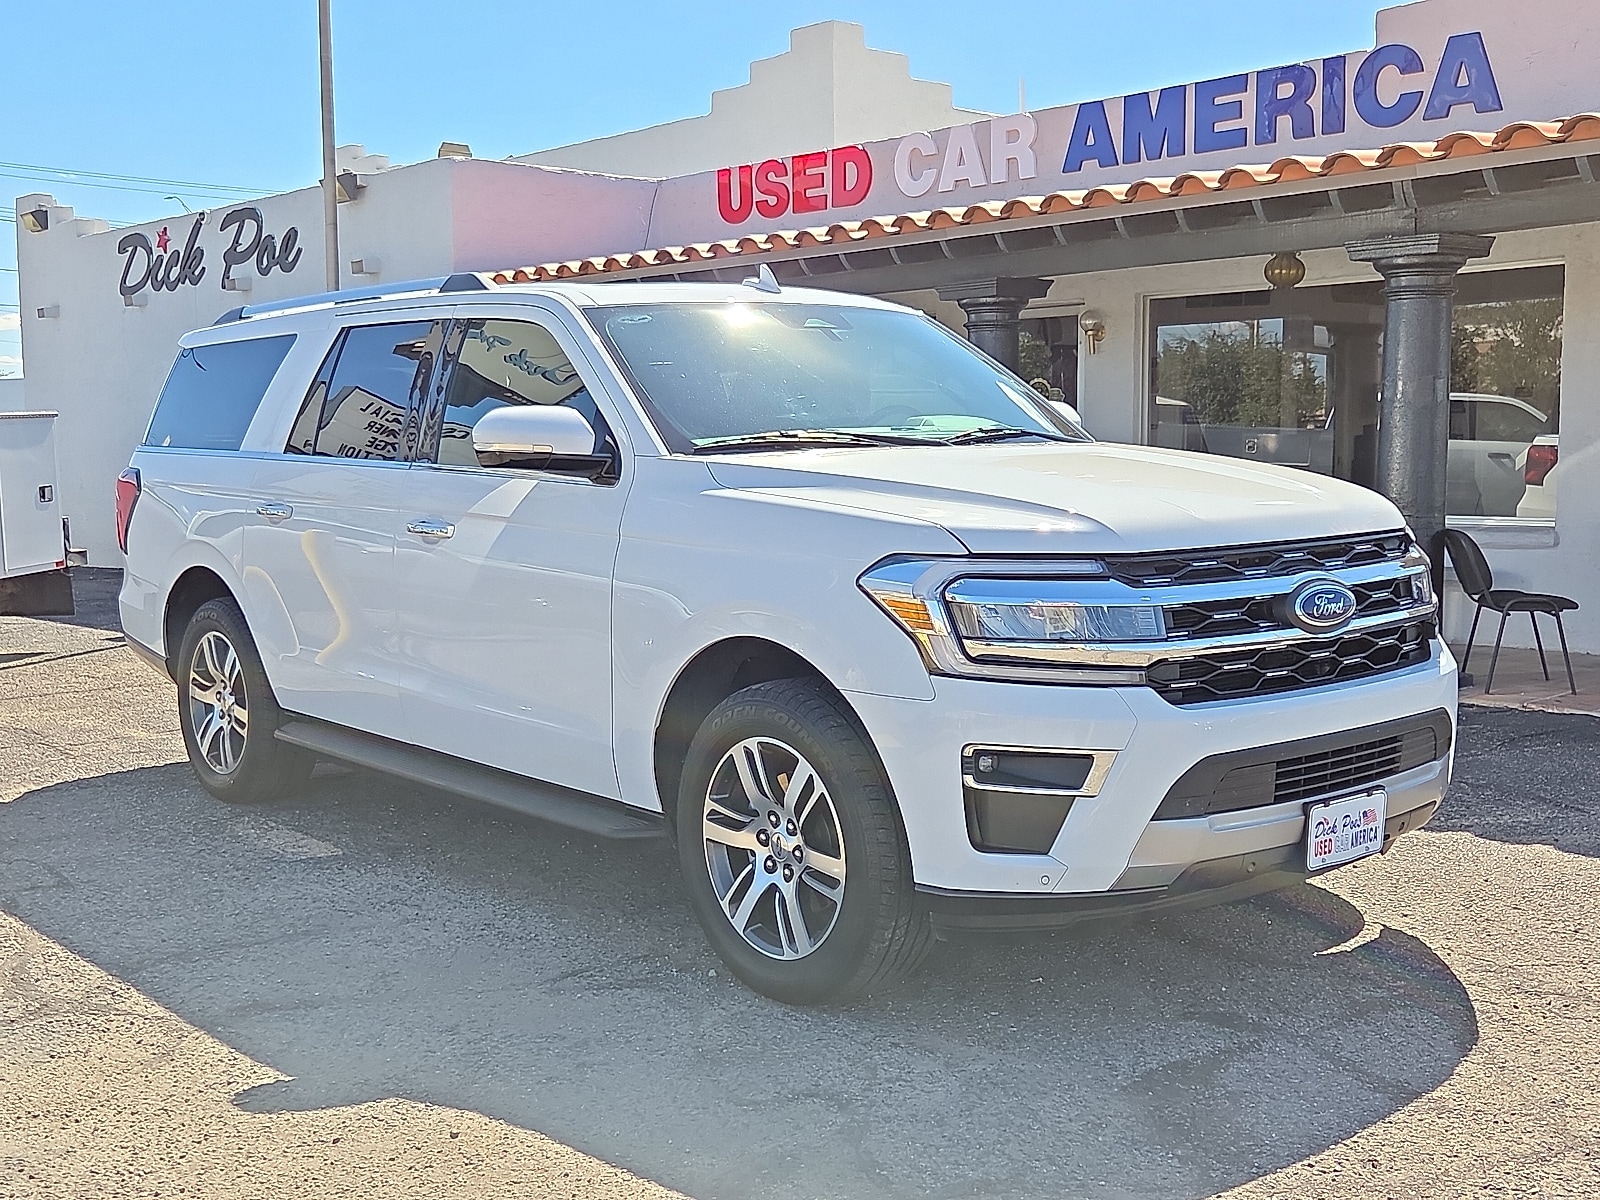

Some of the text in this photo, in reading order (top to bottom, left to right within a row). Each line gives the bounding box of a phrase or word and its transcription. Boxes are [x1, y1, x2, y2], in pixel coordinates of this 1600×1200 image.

[716, 30, 1504, 225] USED CAR AMERICA
[117, 206, 303, 297] Dick Poe
[1313, 593, 1345, 617] Ford
[711, 704, 757, 732] OPEN
[1314, 816, 1339, 839] Dick
[1314, 838, 1333, 857] USED
[1350, 825, 1378, 849] AMERICA
